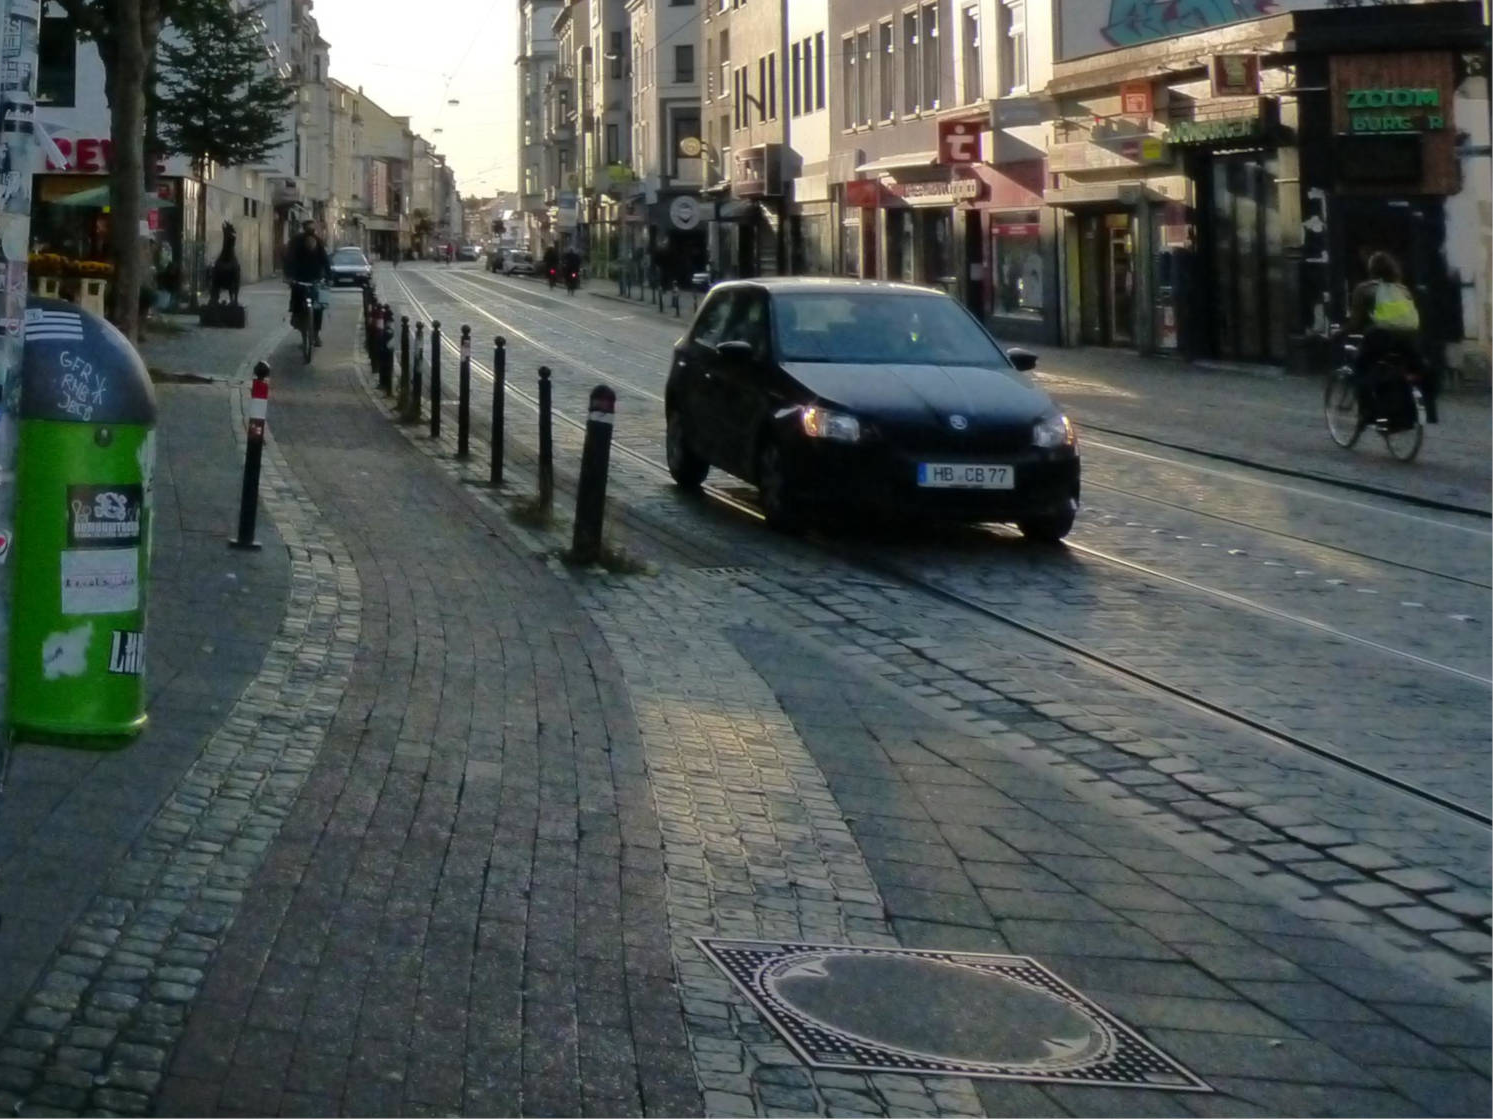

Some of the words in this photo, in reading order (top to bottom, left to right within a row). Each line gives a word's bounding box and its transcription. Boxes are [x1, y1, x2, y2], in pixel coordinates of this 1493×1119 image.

[1346, 88, 1440, 109] ZOOM
[933, 466, 954, 481] HB
[964, 467, 984, 482] CB
[988, 468, 1007, 484] 77
